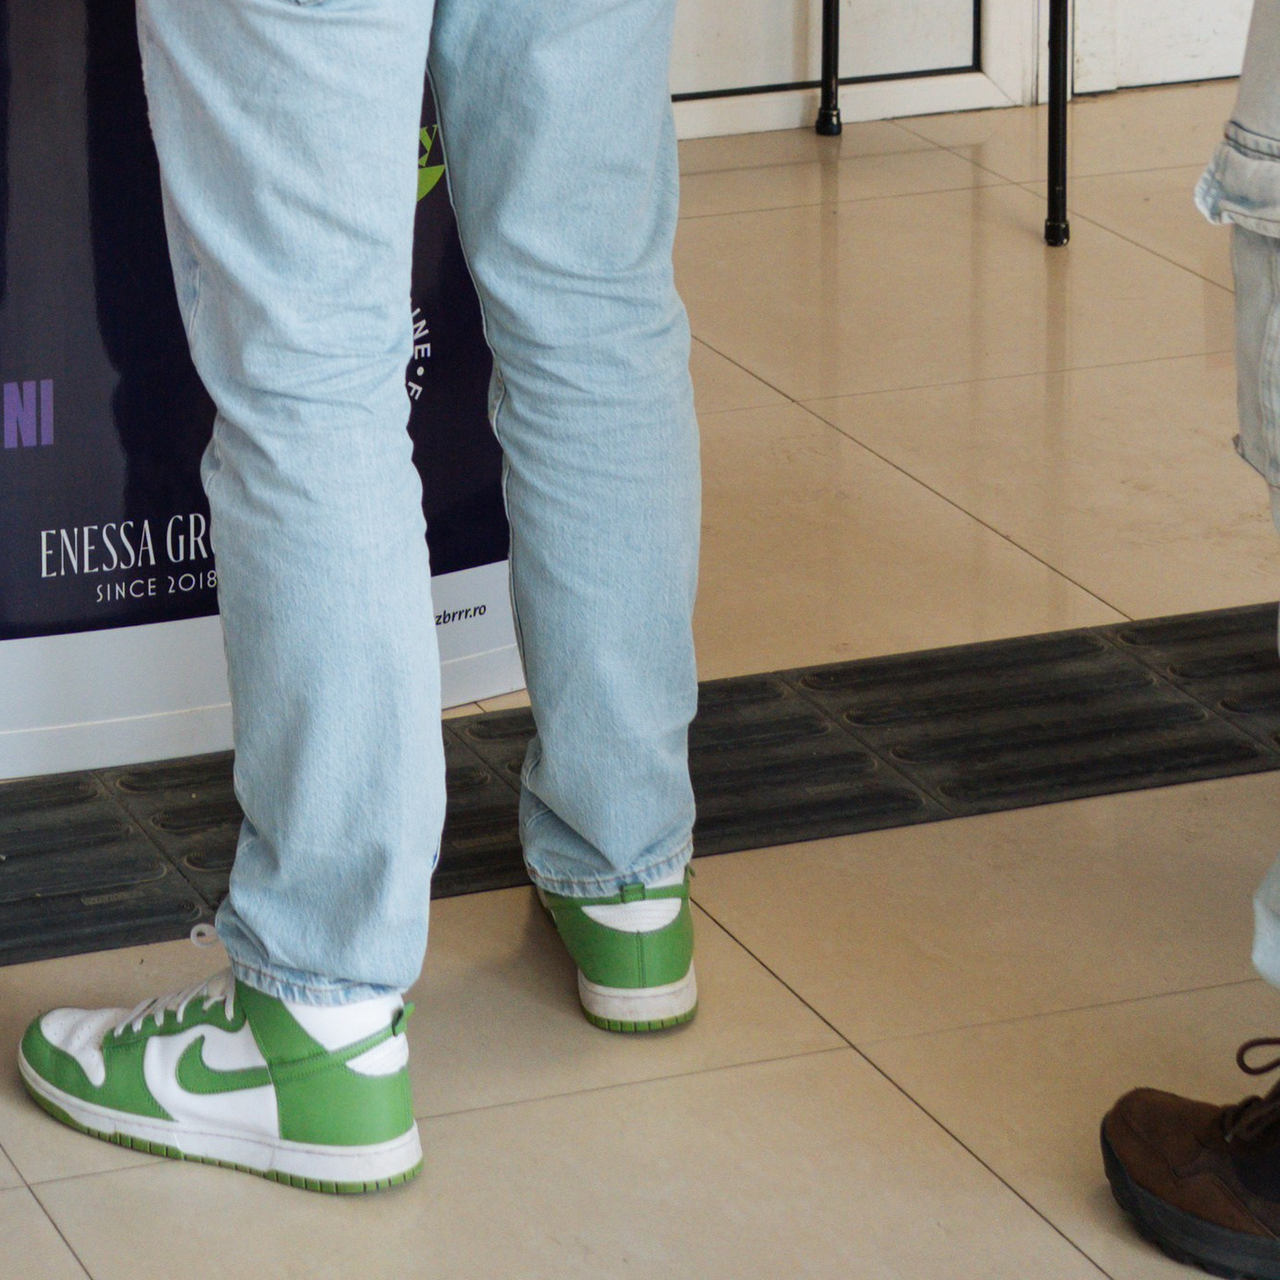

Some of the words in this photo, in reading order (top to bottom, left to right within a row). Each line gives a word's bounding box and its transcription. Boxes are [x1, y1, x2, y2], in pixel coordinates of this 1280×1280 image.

[40, 518, 157, 579] ENESSA
[166, 513, 217, 565] GR
[96, 577, 157, 603] SINCE
[168, 569, 218, 594] 2018
